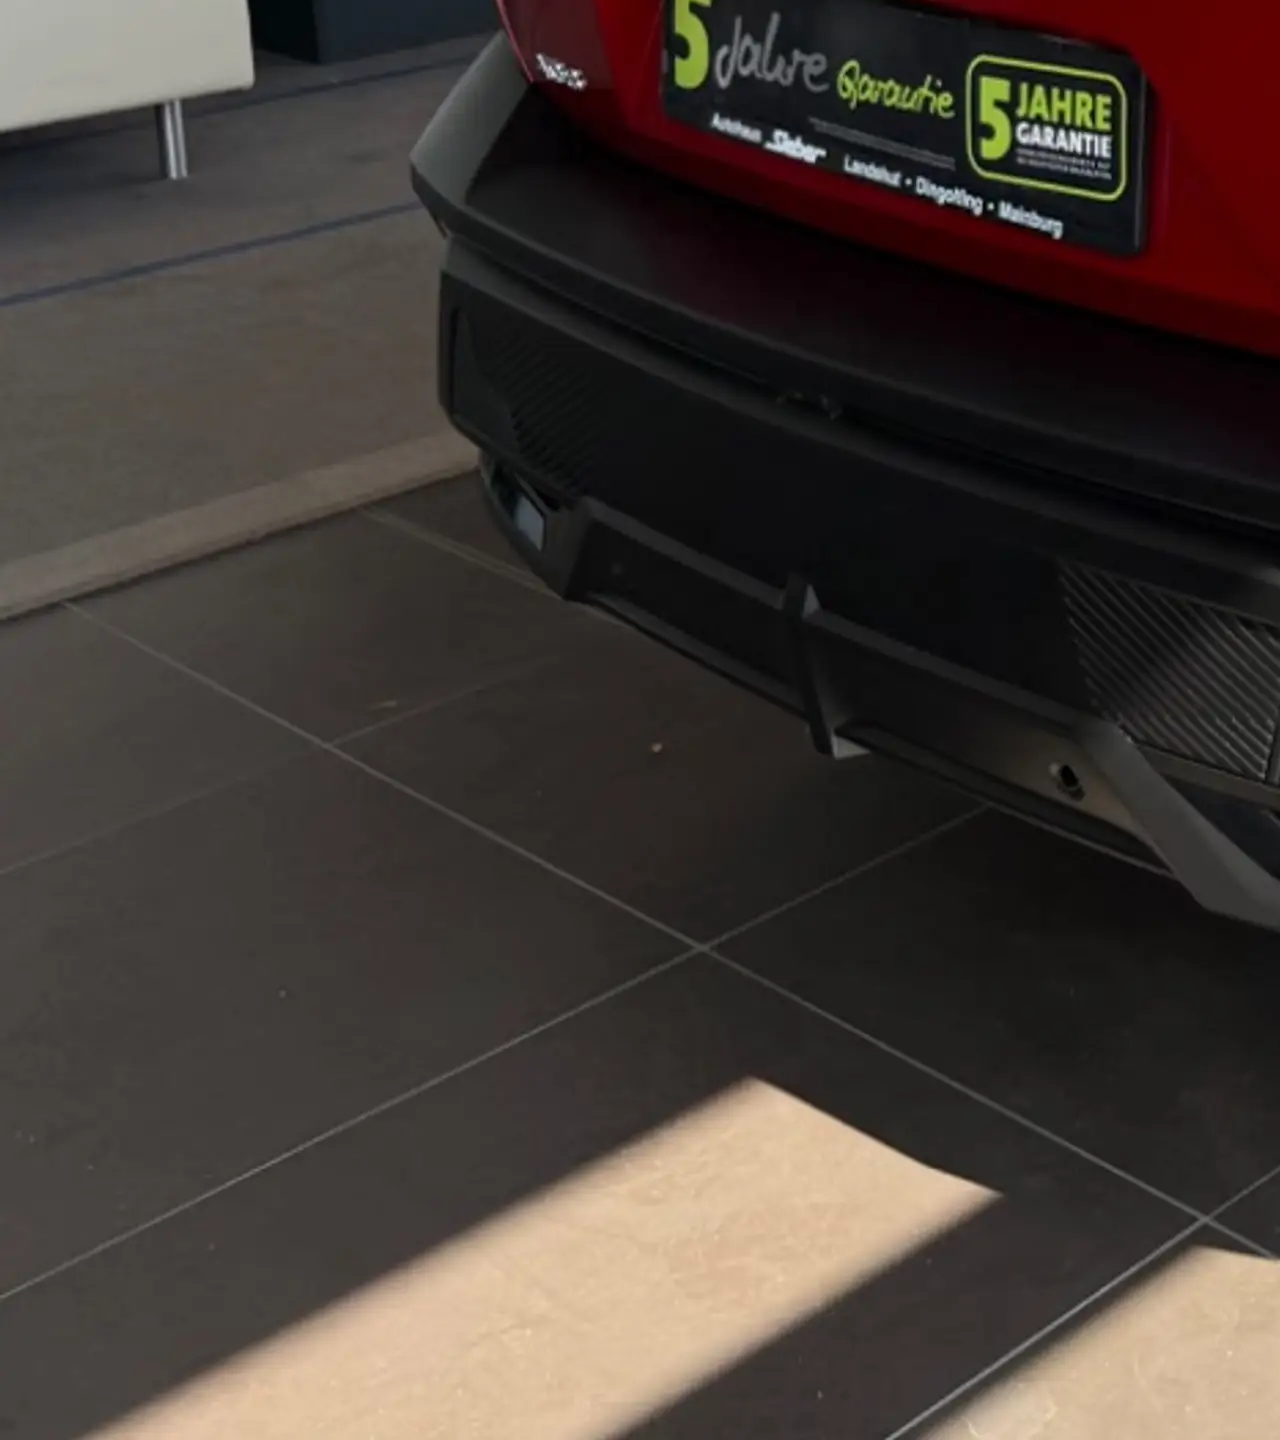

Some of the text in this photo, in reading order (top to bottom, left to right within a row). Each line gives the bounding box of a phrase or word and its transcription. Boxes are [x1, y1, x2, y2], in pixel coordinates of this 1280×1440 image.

[714, 13, 830, 92] Jahre
[837, 60, 956, 119] Garantie
[979, 75, 1012, 160] 5
[1015, 82, 1112, 132] JAHRE
[1015, 121, 1112, 159] GARANTIE
[915, 176, 983, 216] Dingolfing
